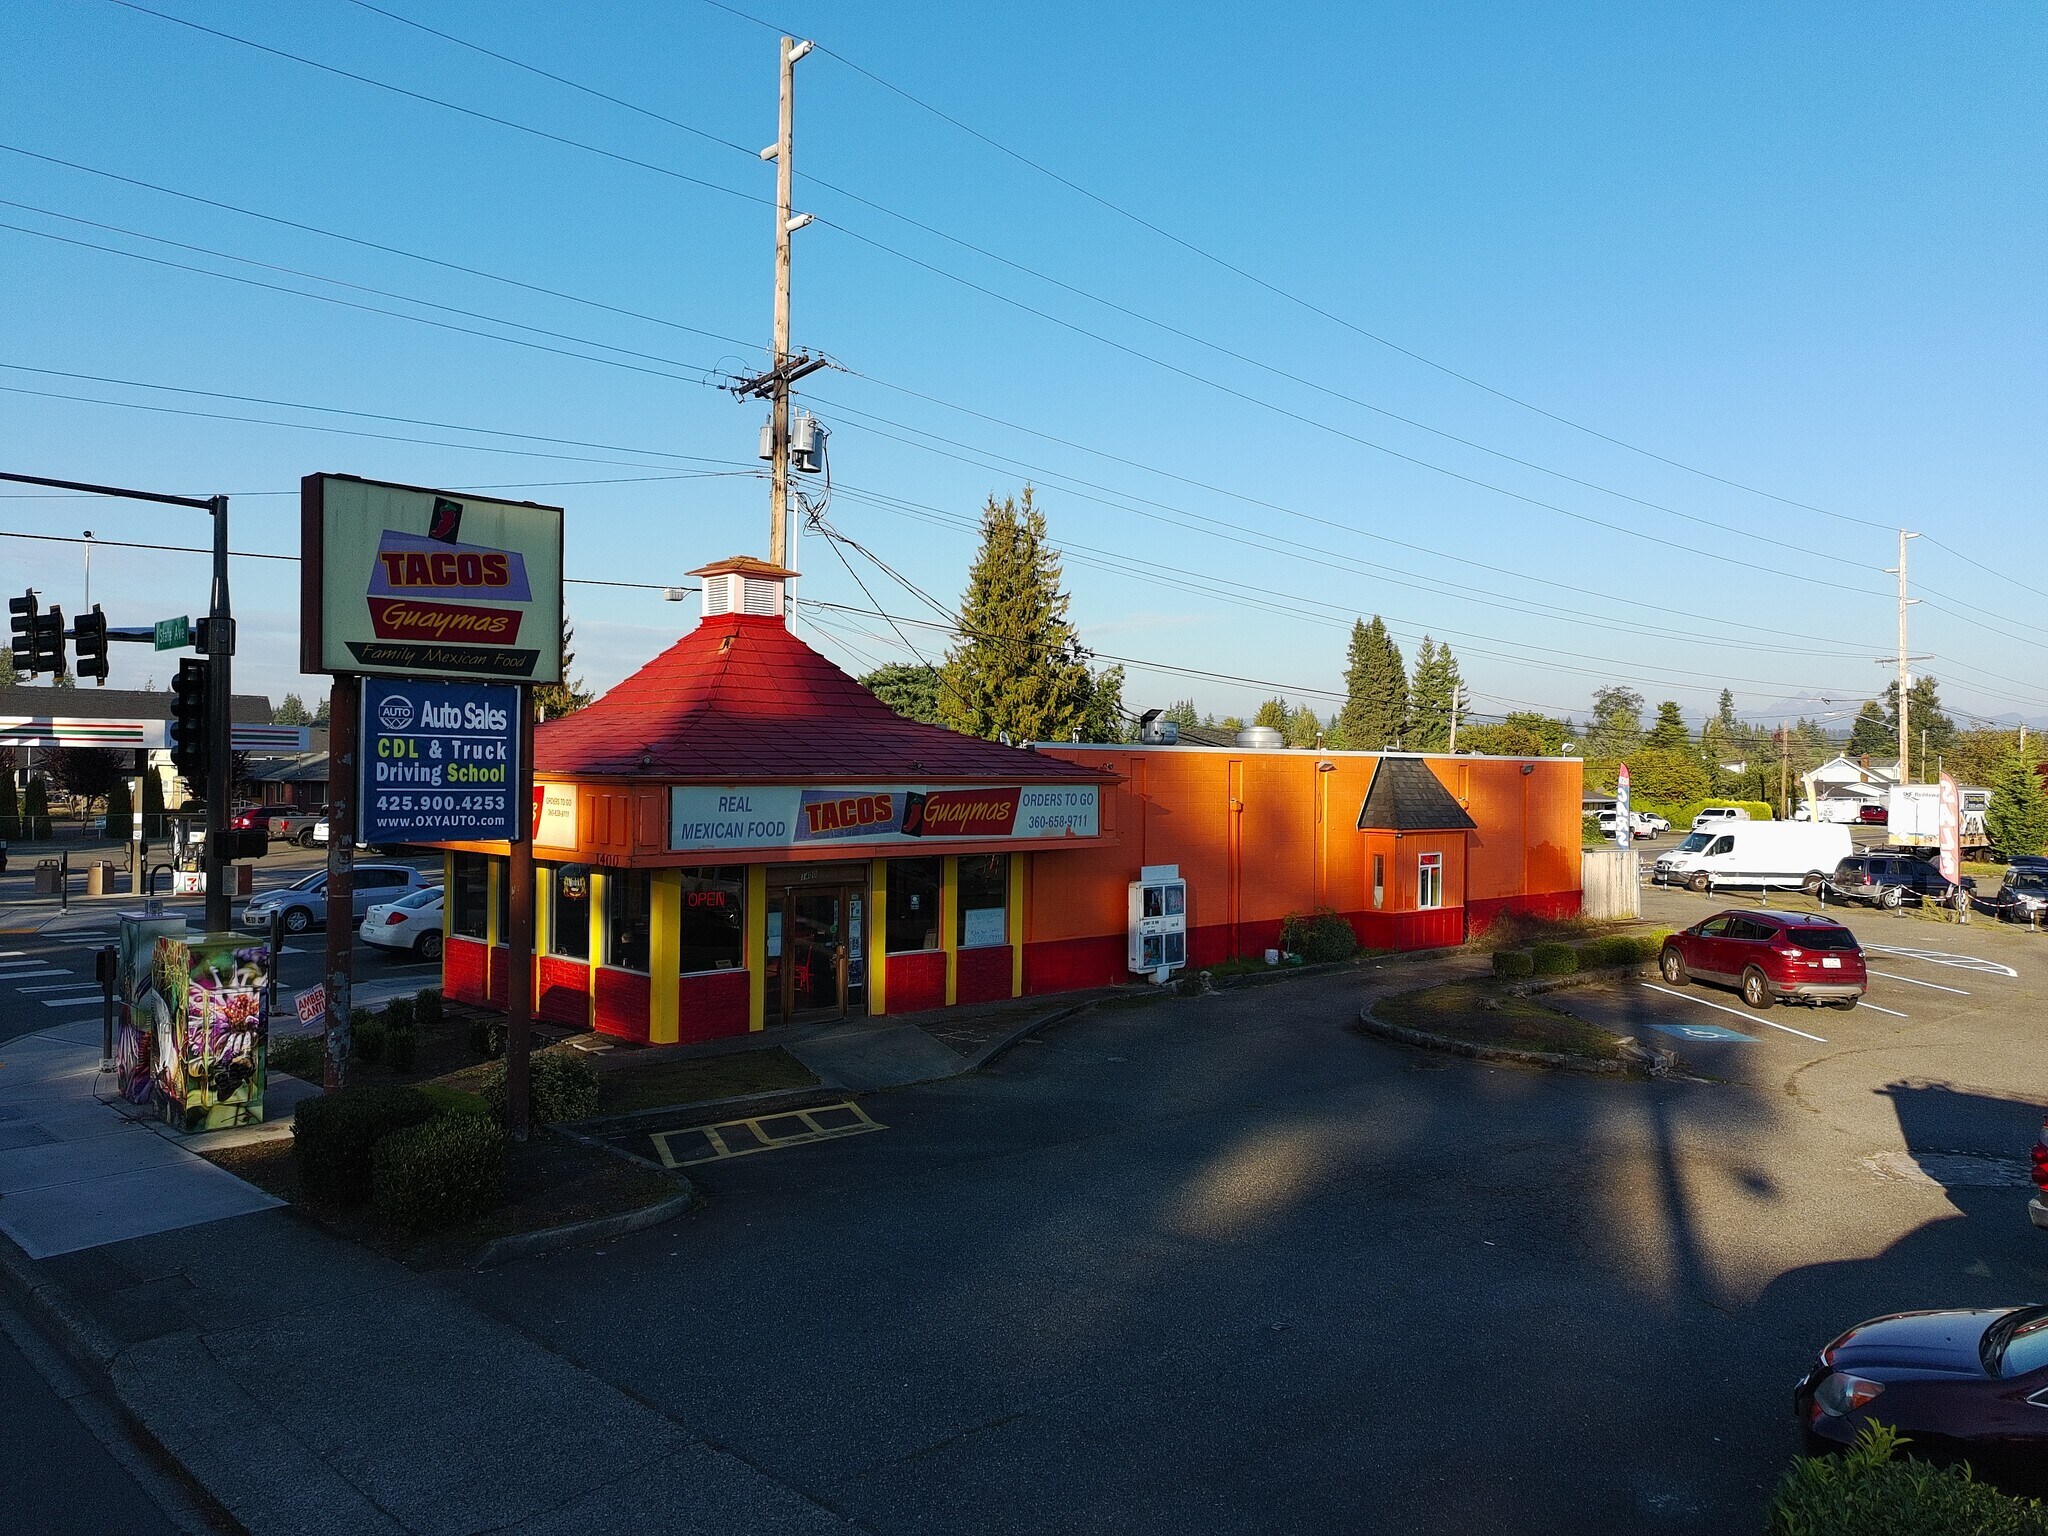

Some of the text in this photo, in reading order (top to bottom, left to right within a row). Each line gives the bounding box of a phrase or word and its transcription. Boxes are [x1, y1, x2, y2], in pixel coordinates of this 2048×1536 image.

[379, 552, 511, 588] TACOS
[382, 603, 509, 638] Guaymas
[361, 645, 527, 668] Family Mexican Food
[382, 707, 411, 717] AUTO
[420, 700, 507, 730] Auto Sales
[378, 738, 507, 760] CDL & Truck
[377, 762, 505, 786] Driving School
[377, 796, 505, 811] 425.900.4253
[718, 796, 752, 813] REAL
[1022, 792, 1094, 807] ORDERS TO GO
[377, 815, 505, 827] www.OXYAUTO.com
[805, 794, 893, 834] TACOS
[923, 795, 1011, 833] Guaymas
[1028, 814, 1088, 829] 360-658-9711
[681, 821, 786, 840] MEXICAN FOOD
[596, 853, 619, 867] 1400
[688, 892, 726, 907] OPEN
[298, 990, 325, 1011] AMBER
